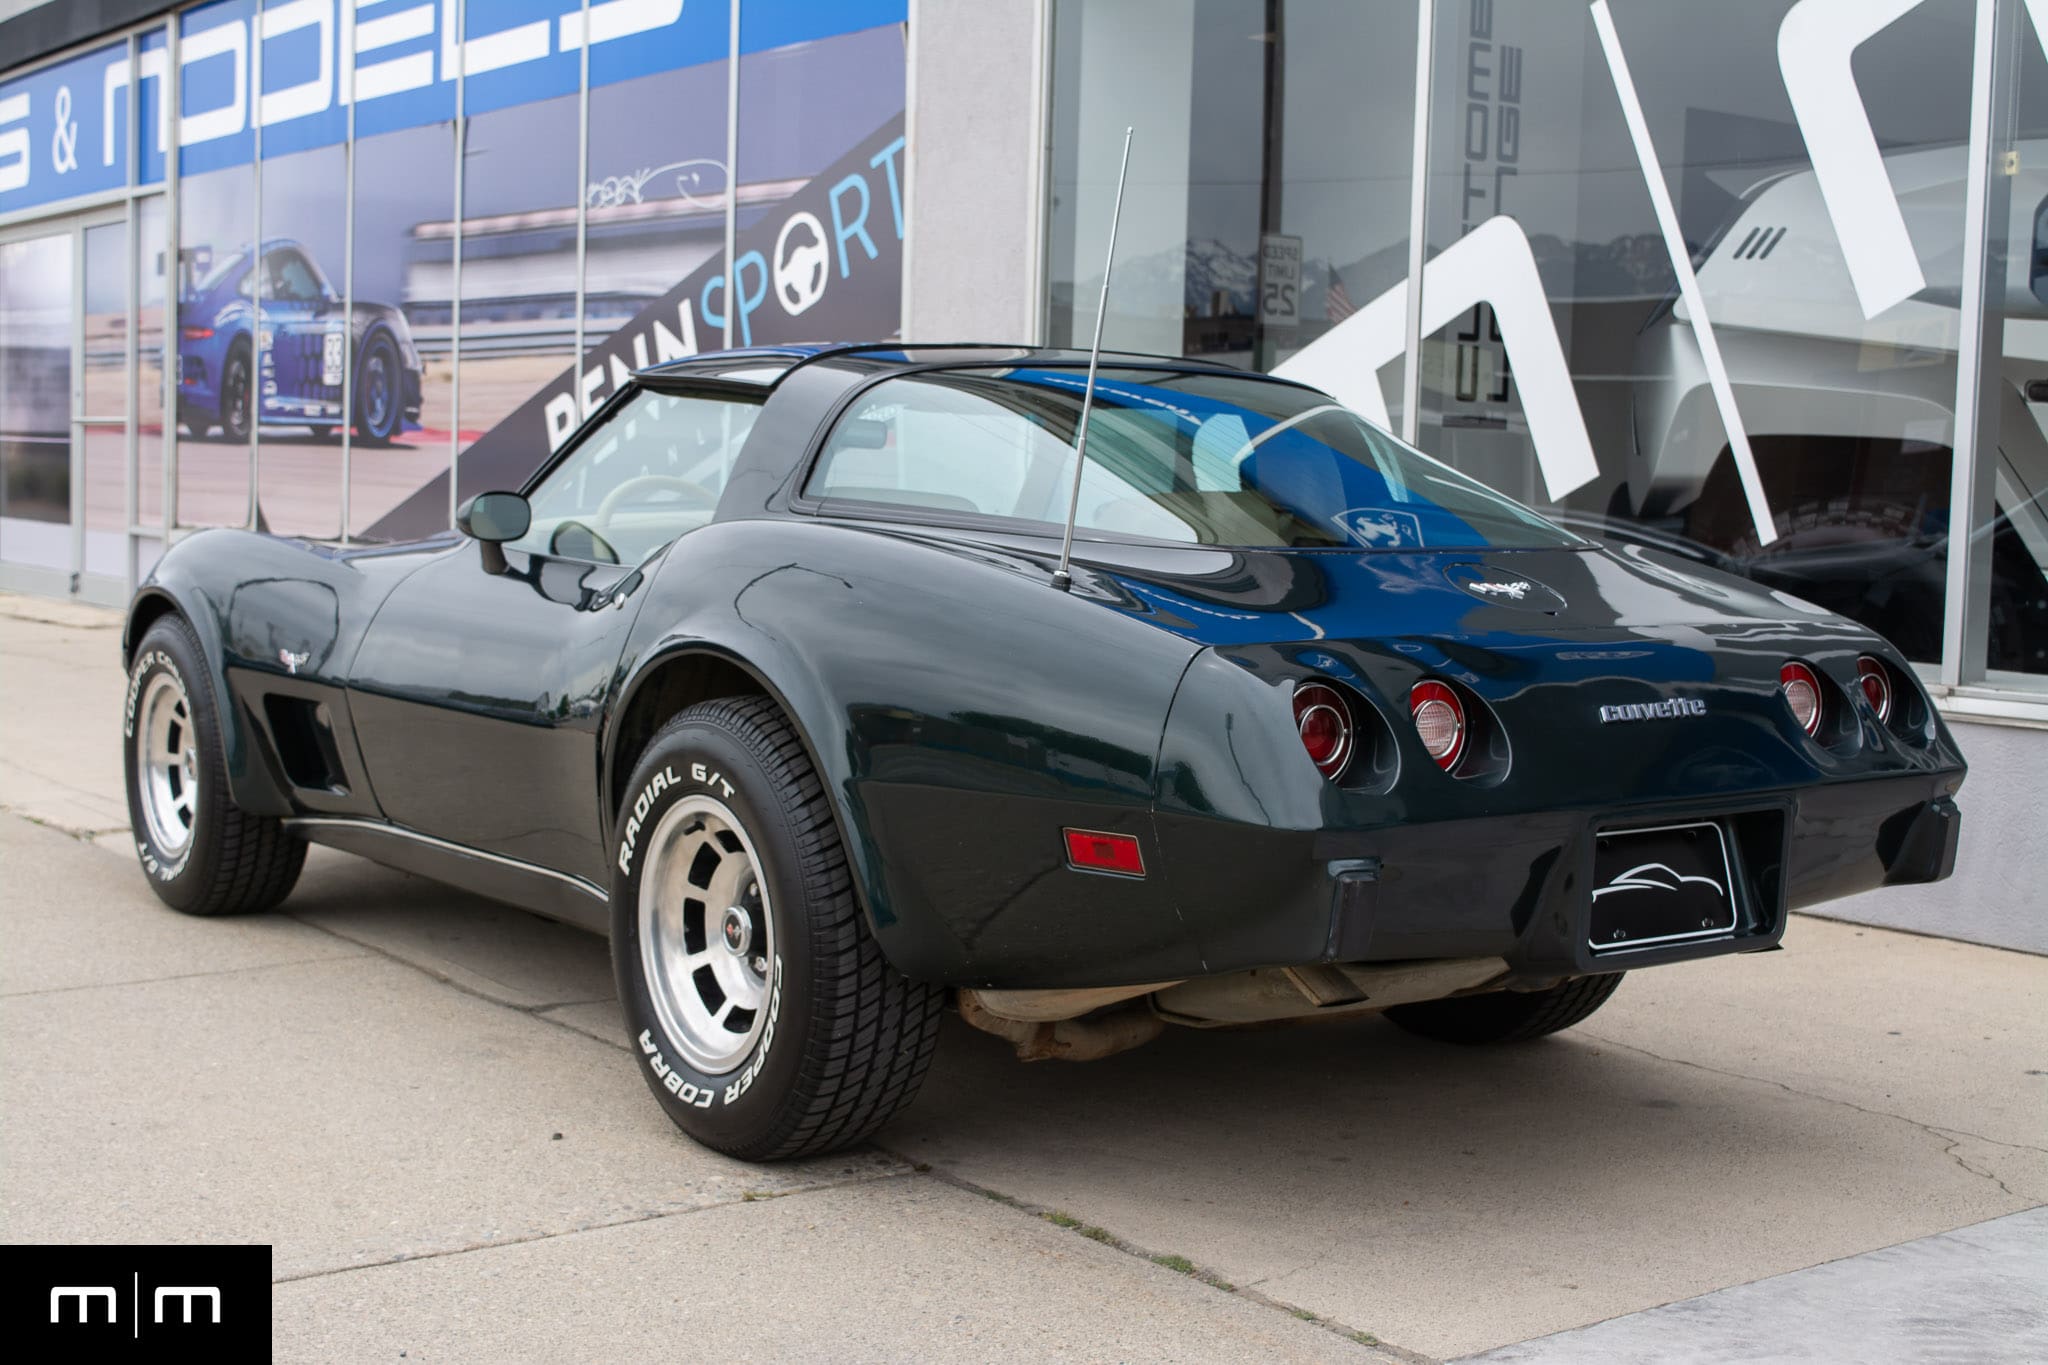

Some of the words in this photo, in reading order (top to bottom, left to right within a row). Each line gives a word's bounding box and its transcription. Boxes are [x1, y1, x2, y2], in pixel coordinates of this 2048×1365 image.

[52, 85, 78, 175] &
[125, 651, 155, 738] COOPER
[618, 765, 682, 877] RADIAL
[691, 762, 736, 799] G/T
[638, 1028, 715, 1109] COBRA
[723, 953, 783, 1105] COOPER
